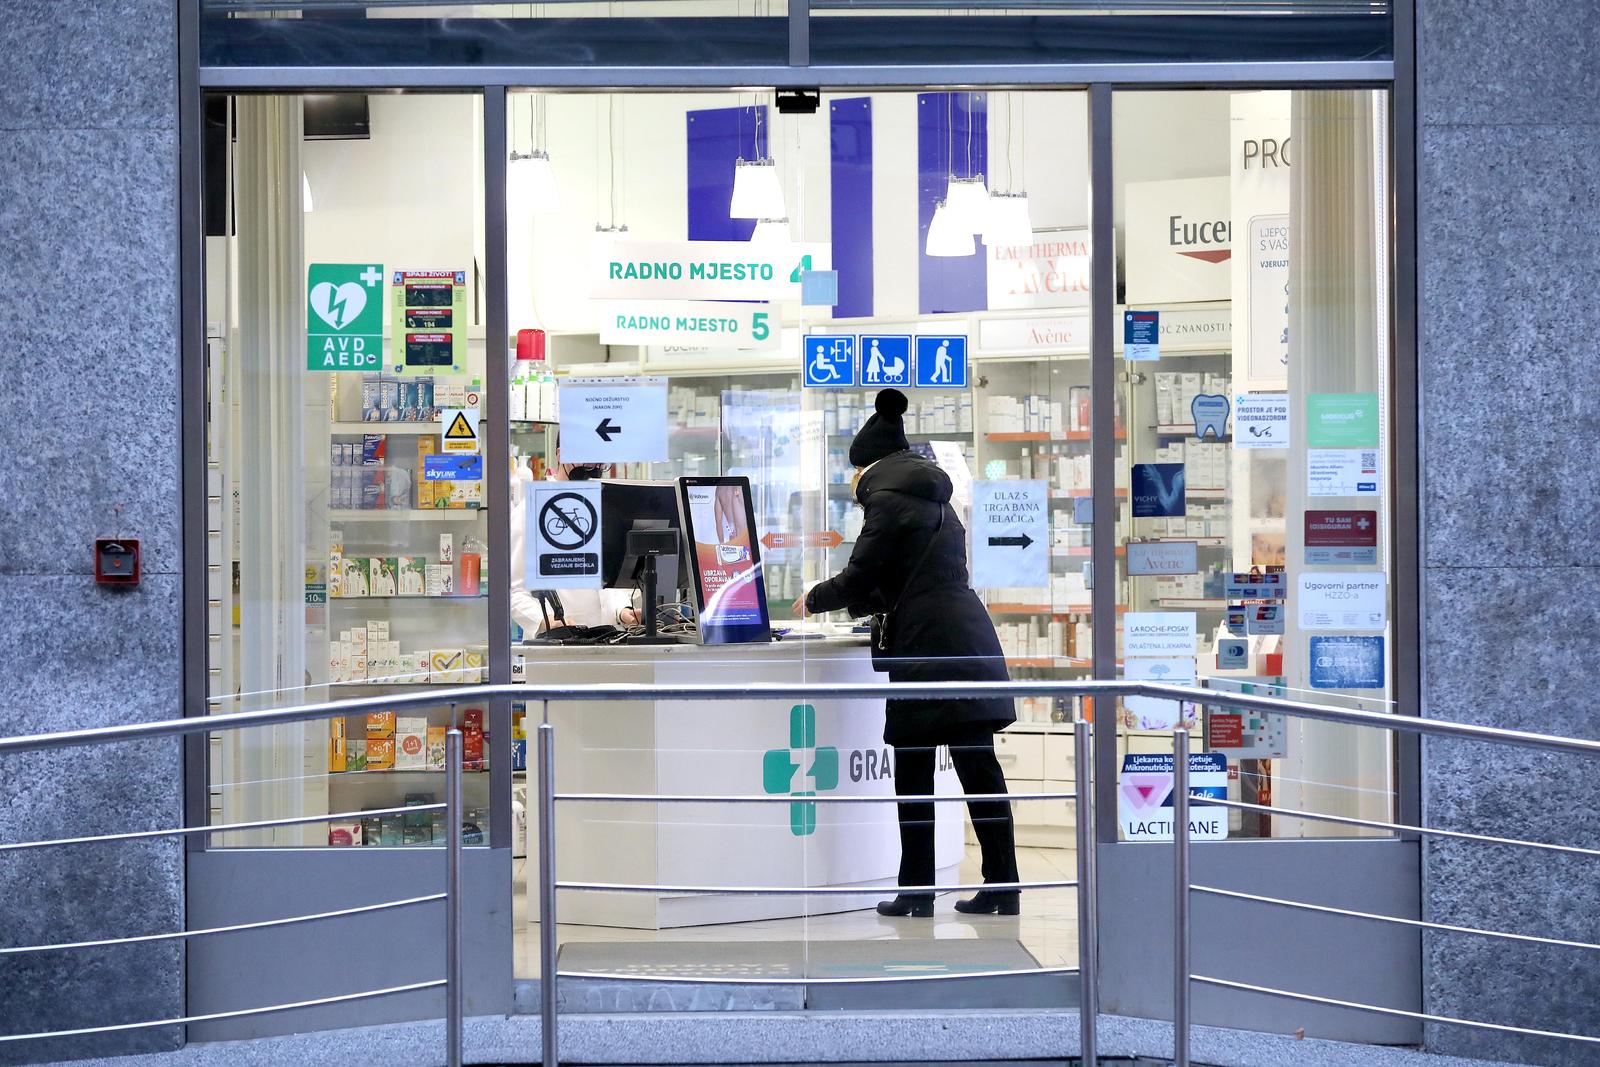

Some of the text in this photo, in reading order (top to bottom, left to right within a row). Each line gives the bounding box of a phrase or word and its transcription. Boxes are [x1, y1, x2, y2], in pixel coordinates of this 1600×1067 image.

[1028, 240, 1089, 259] THERMA
[609, 262, 683, 280] RADNO
[689, 262, 774, 281] MJESTO
[616, 313, 769, 341] RADNO MJESTO 5
[1176, 323, 1226, 334] ZNANOSTI
[1029, 327, 1072, 344] Avène
[323, 338, 365, 351] AVD
[323, 353, 364, 366] AED
[994, 491, 1029, 500] ULAZ S
[983, 503, 1040, 512] TRGA BANA
[1304, 582, 1379, 591] Ugovorni partner
[1133, 756, 1163, 764] Ljekarna
[1164, 756, 1174, 764] ko
[1125, 764, 1173, 773] Mikronutriciju
[1129, 821, 1219, 835] LACTIANE
